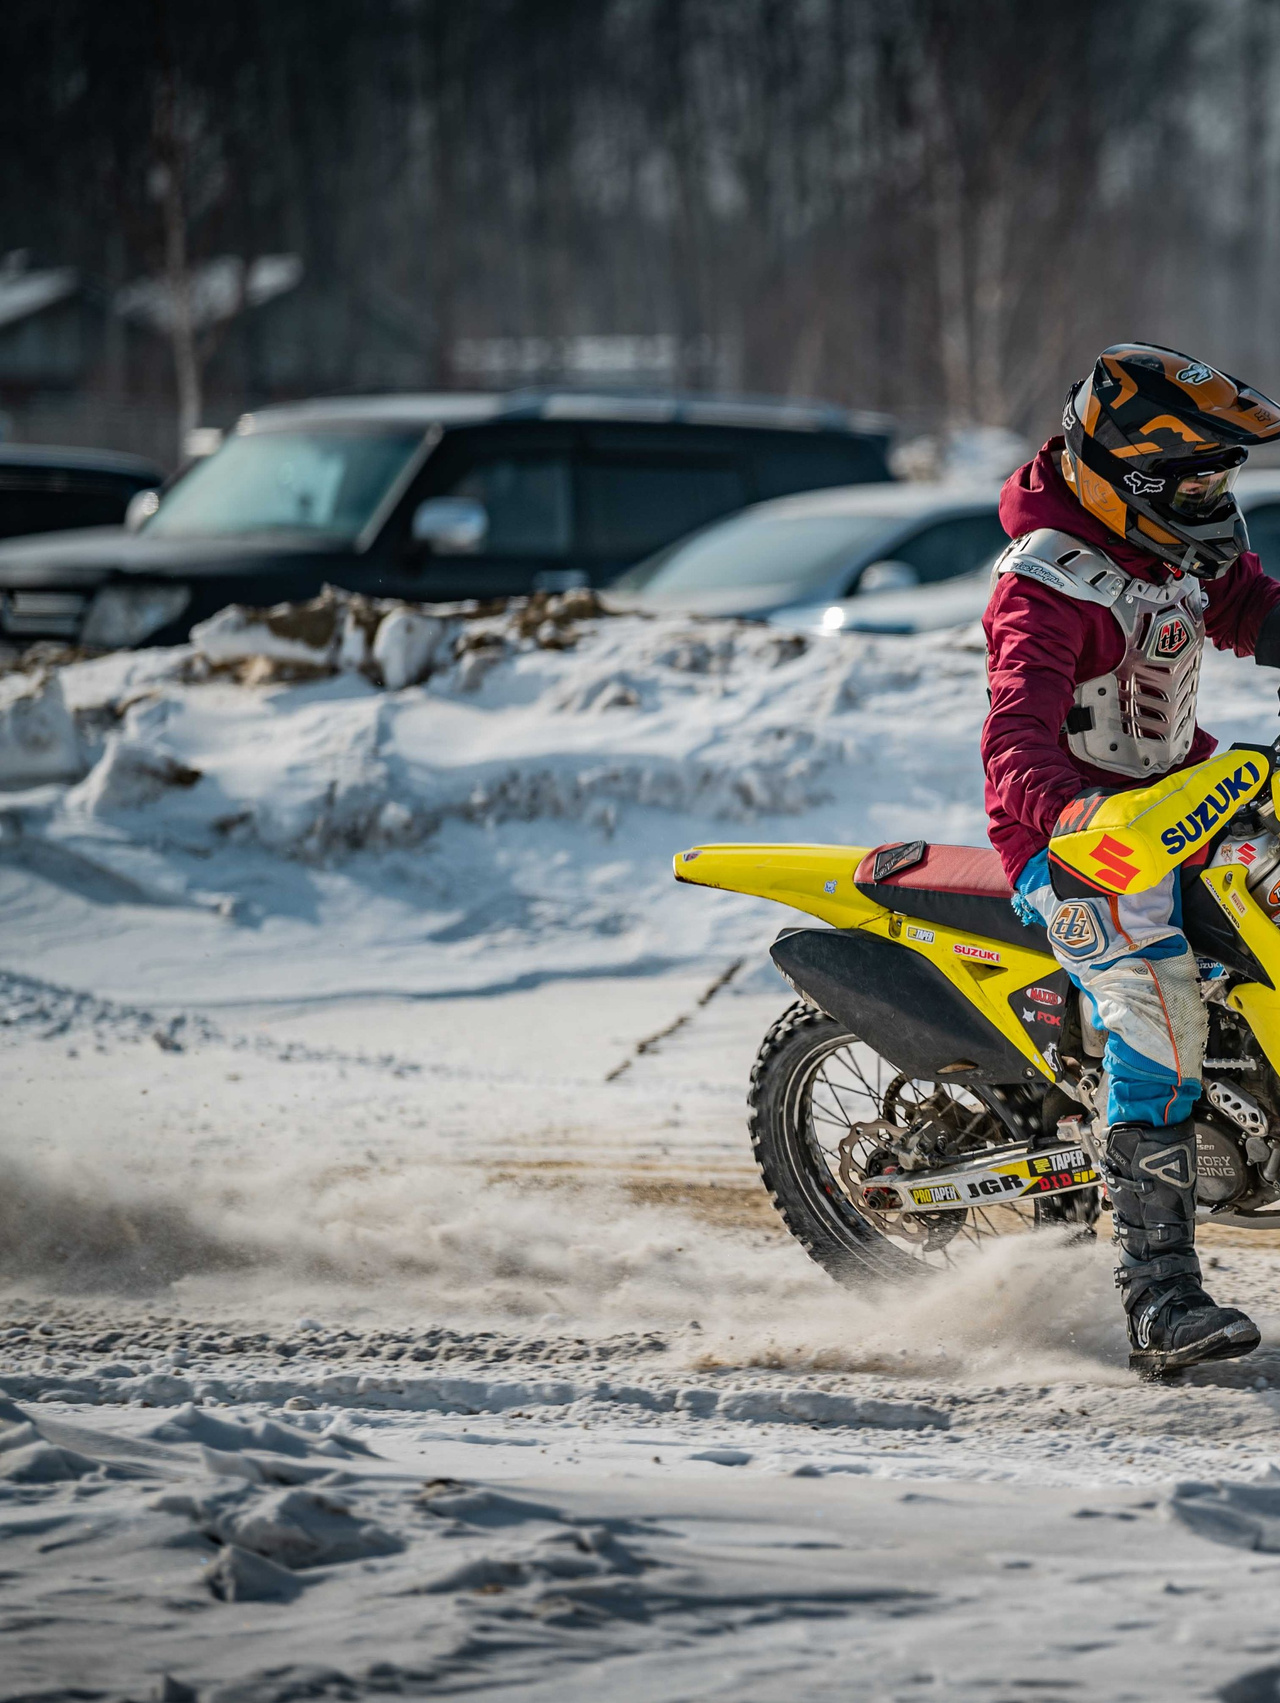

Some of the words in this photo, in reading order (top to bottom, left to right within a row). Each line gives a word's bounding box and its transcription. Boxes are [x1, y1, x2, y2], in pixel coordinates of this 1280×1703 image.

[1161, 761, 1260, 855] SUZUKI
[954, 945, 999, 961] SUZUKI
[1198, 961, 1224, 969] UZUKI
[1030, 988, 1059, 1005] MAXXIS
[1037, 1010, 1061, 1026] FOX
[1049, 1150, 1085, 1172] TAPER
[1197, 1156, 1231, 1166] TORY
[1197, 1167, 1236, 1176] CING
[967, 1174, 1024, 1199] JGR
